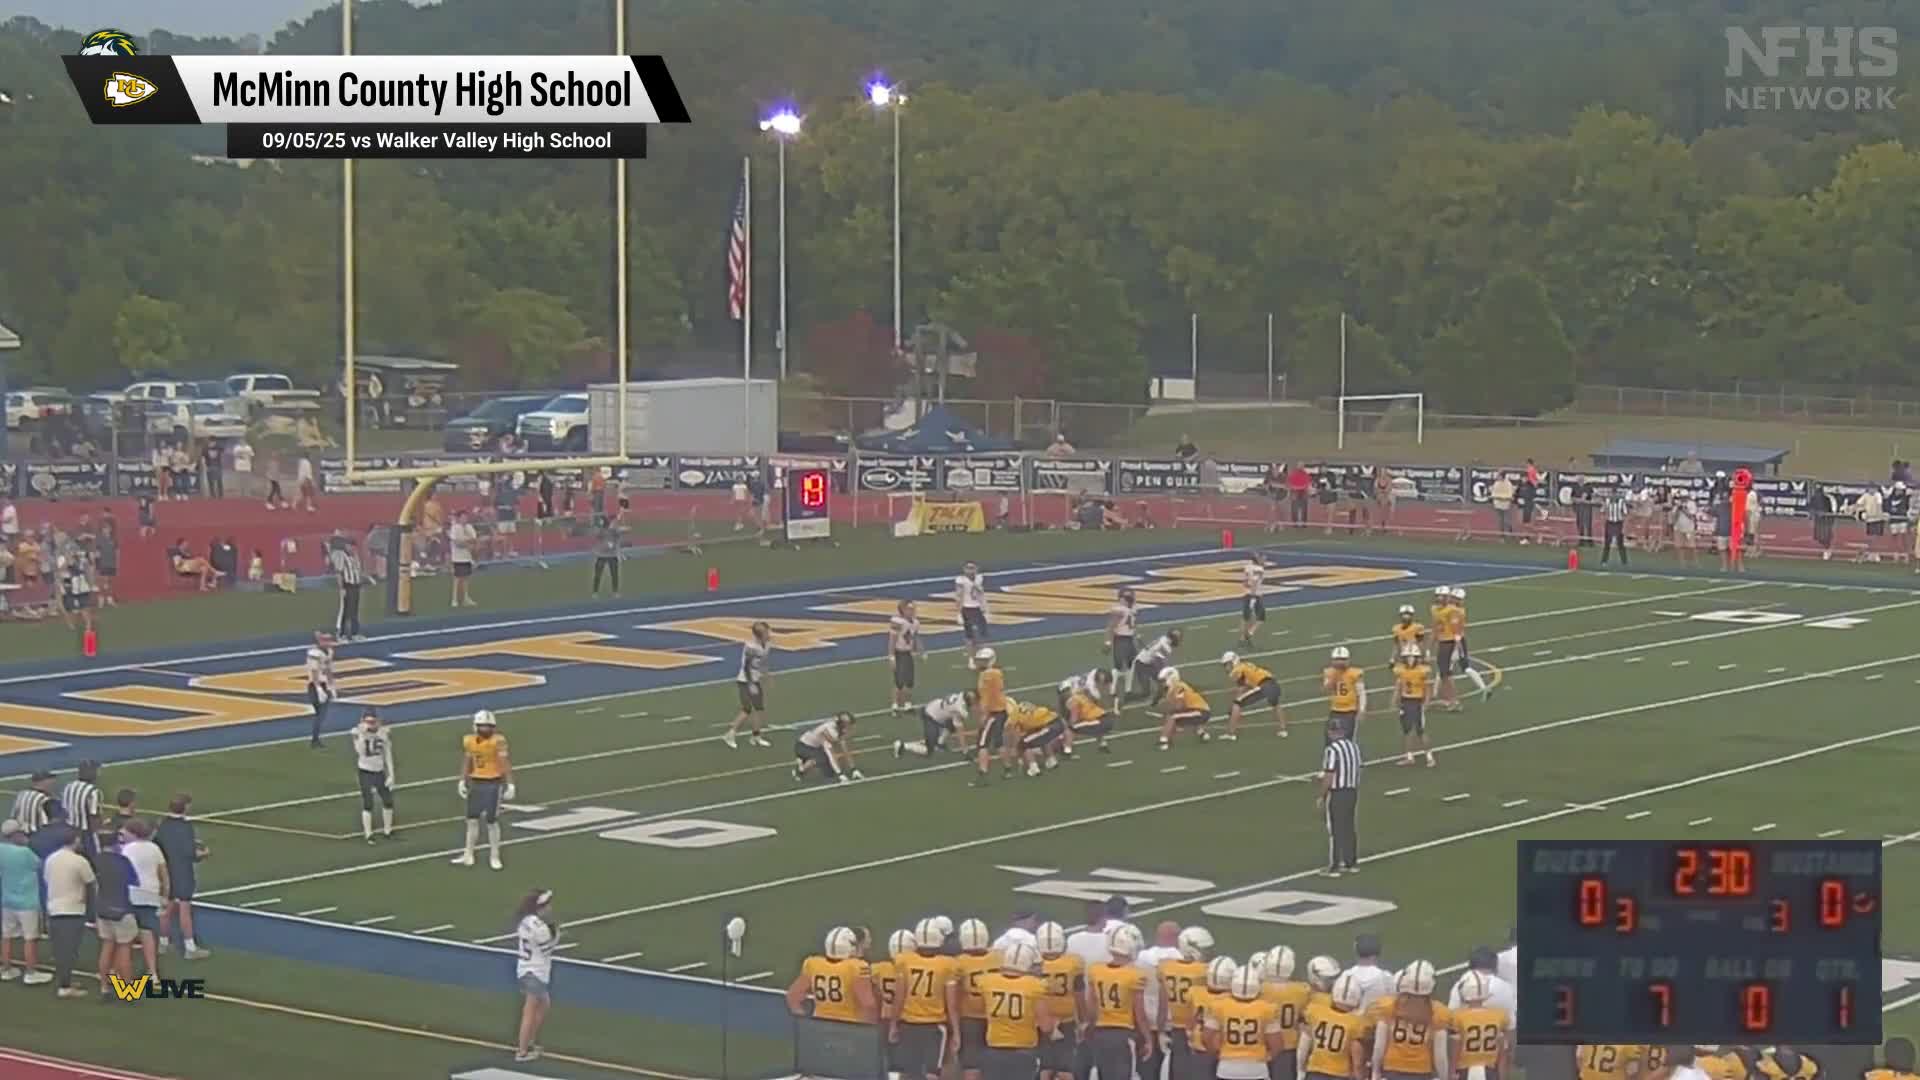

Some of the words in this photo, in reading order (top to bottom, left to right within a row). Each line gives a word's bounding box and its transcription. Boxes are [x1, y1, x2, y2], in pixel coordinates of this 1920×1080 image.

[814, 974, 843, 1003] 68
[911, 967, 934, 998] 71
[1099, 982, 1121, 1009] 14
[991, 990, 1022, 1020] 70
[1227, 1016, 1258, 1045] 62
[1314, 1020, 1345, 1052] 40
[1465, 1023, 1497, 1052] 22
